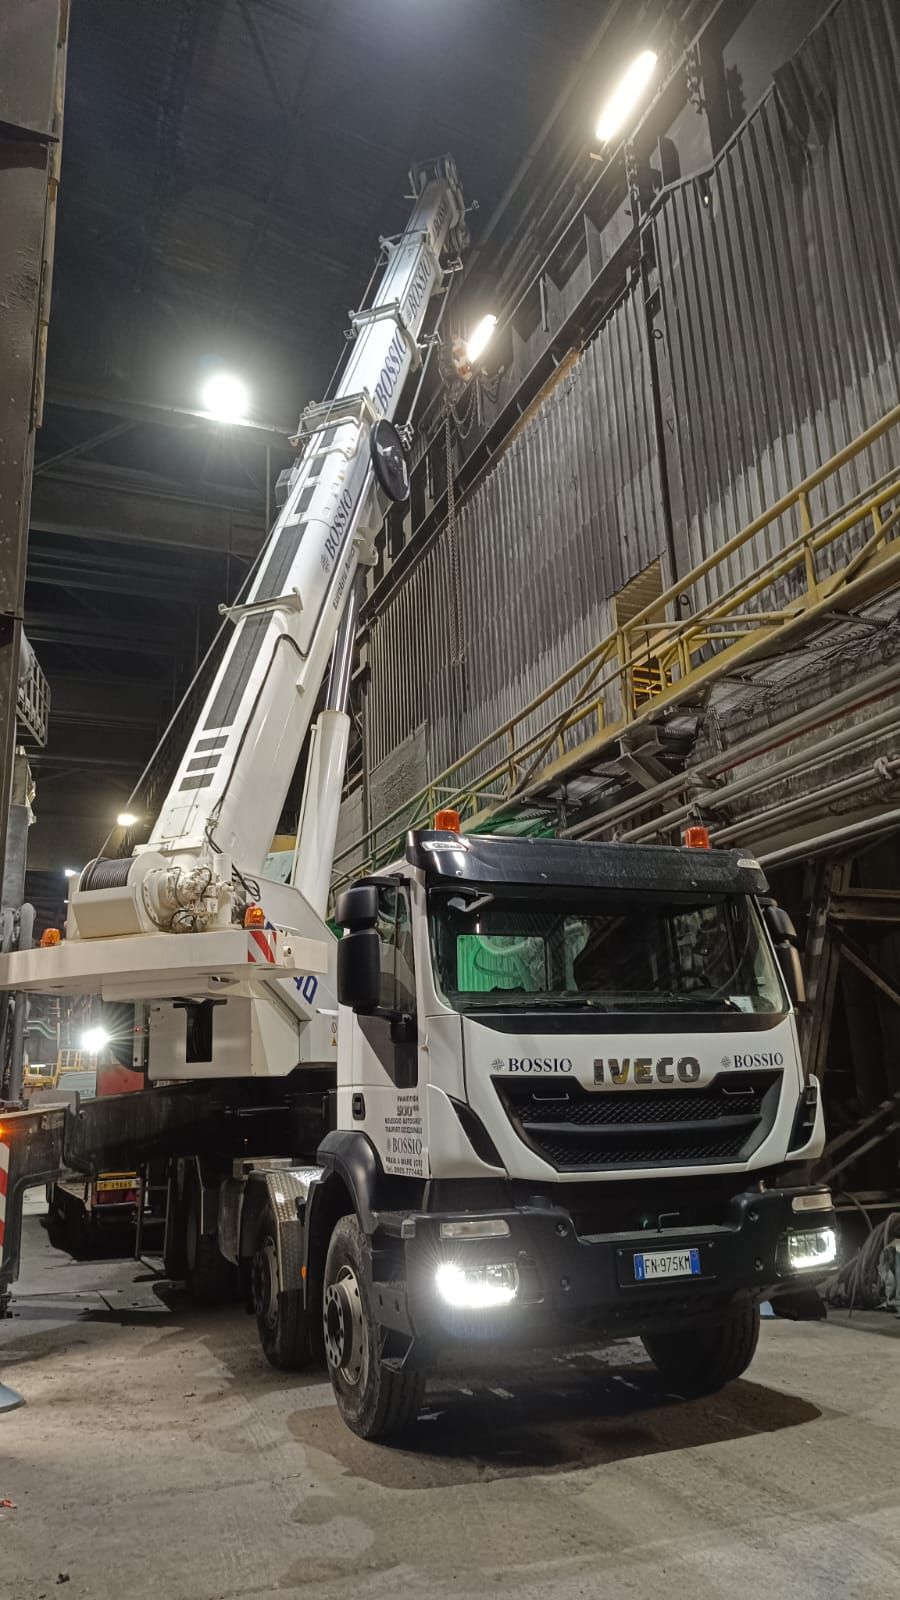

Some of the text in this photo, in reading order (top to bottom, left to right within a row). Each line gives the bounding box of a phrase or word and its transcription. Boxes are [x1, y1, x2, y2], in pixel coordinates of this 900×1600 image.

[408, 254, 432, 319] BOSSIO
[325, 488, 352, 560] BOSSIO
[508, 1057, 573, 1073] BOSSIO
[593, 1057, 701, 1086] IVECO
[733, 1052, 784, 1069] BOSSIO
[392, 1137, 423, 1156] BOSSIO
